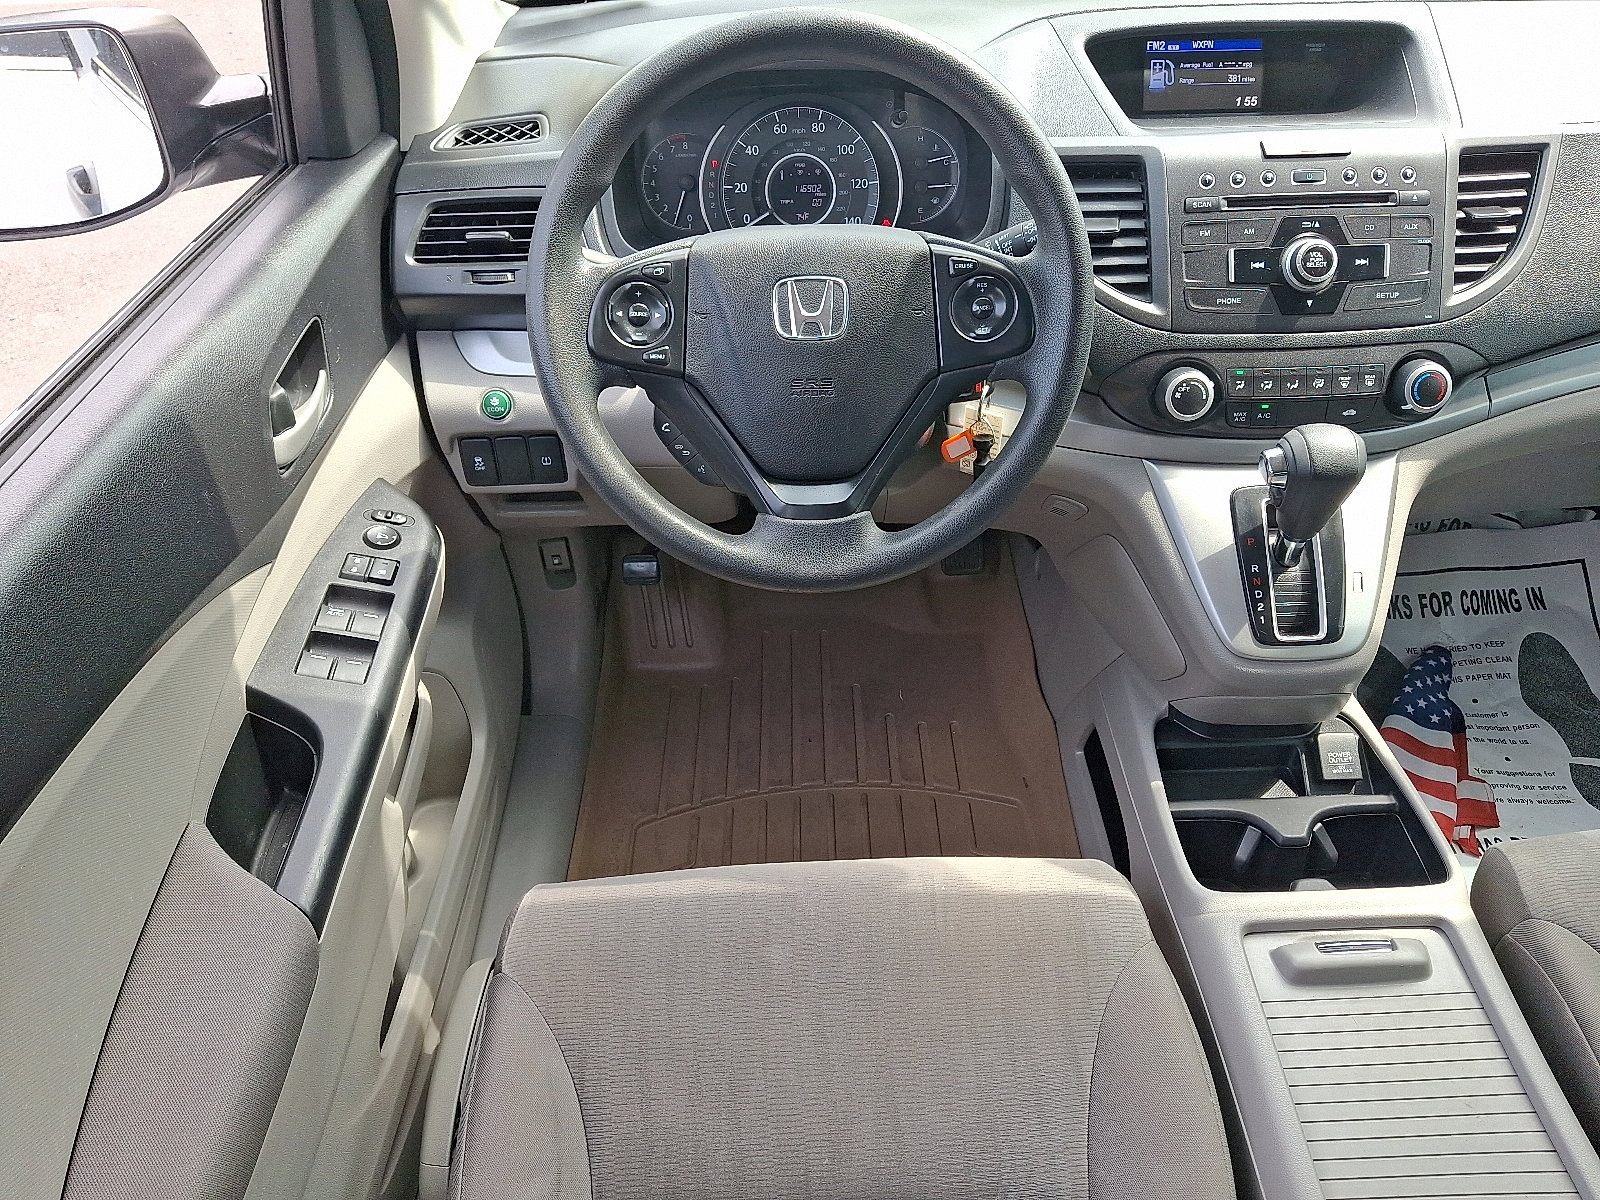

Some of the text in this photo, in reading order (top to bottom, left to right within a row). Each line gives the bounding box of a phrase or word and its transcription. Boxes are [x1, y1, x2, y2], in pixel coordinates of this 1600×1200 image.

[1146, 41, 1166, 51] FM2
[1192, 40, 1215, 49] WXPN
[1180, 62, 1200, 70] Average
[773, 124, 788, 135] 60
[811, 122, 825, 133] 80
[670, 145, 675, 153] 7
[745, 145, 760, 156] 40
[836, 144, 855, 155] 100
[658, 152, 664, 160] 6
[734, 182, 748, 193] 20
[850, 178, 868, 189] 120
[654, 193, 660, 201] 3
[663, 204, 668, 212] 2
[686, 214, 693, 222] 0
[743, 214, 750, 224] 0
[844, 217, 862, 225] 140
[1375, 291, 1400, 299] SETUP
[1216, 297, 1242, 305] PHONE
[1251, 564, 1259, 572] R
[1253, 577, 1261, 585] N
[1255, 590, 1263, 598] D
[1418, 591, 1455, 619] FOR
[1460, 588, 1523, 616] COMING
[1525, 586, 1548, 611] IN
[1257, 603, 1265, 611] 2
[1259, 616, 1265, 624] 1
[1449, 645, 1468, 653] RIED
[1484, 640, 1506, 648] KEEP
[1452, 655, 1513, 667] PETING CLEAN
[1465, 673, 1493, 682] PAPER
[1495, 672, 1512, 680] MAT
[1475, 724, 1512, 732] important
[1512, 723, 1541, 733] person
[1487, 737, 1508, 745] world
[1474, 767, 1494, 776] Your
[1496, 768, 1543, 778] suggestions
[1488, 783, 1522, 792] proving
[1506, 796, 1534, 806] always
